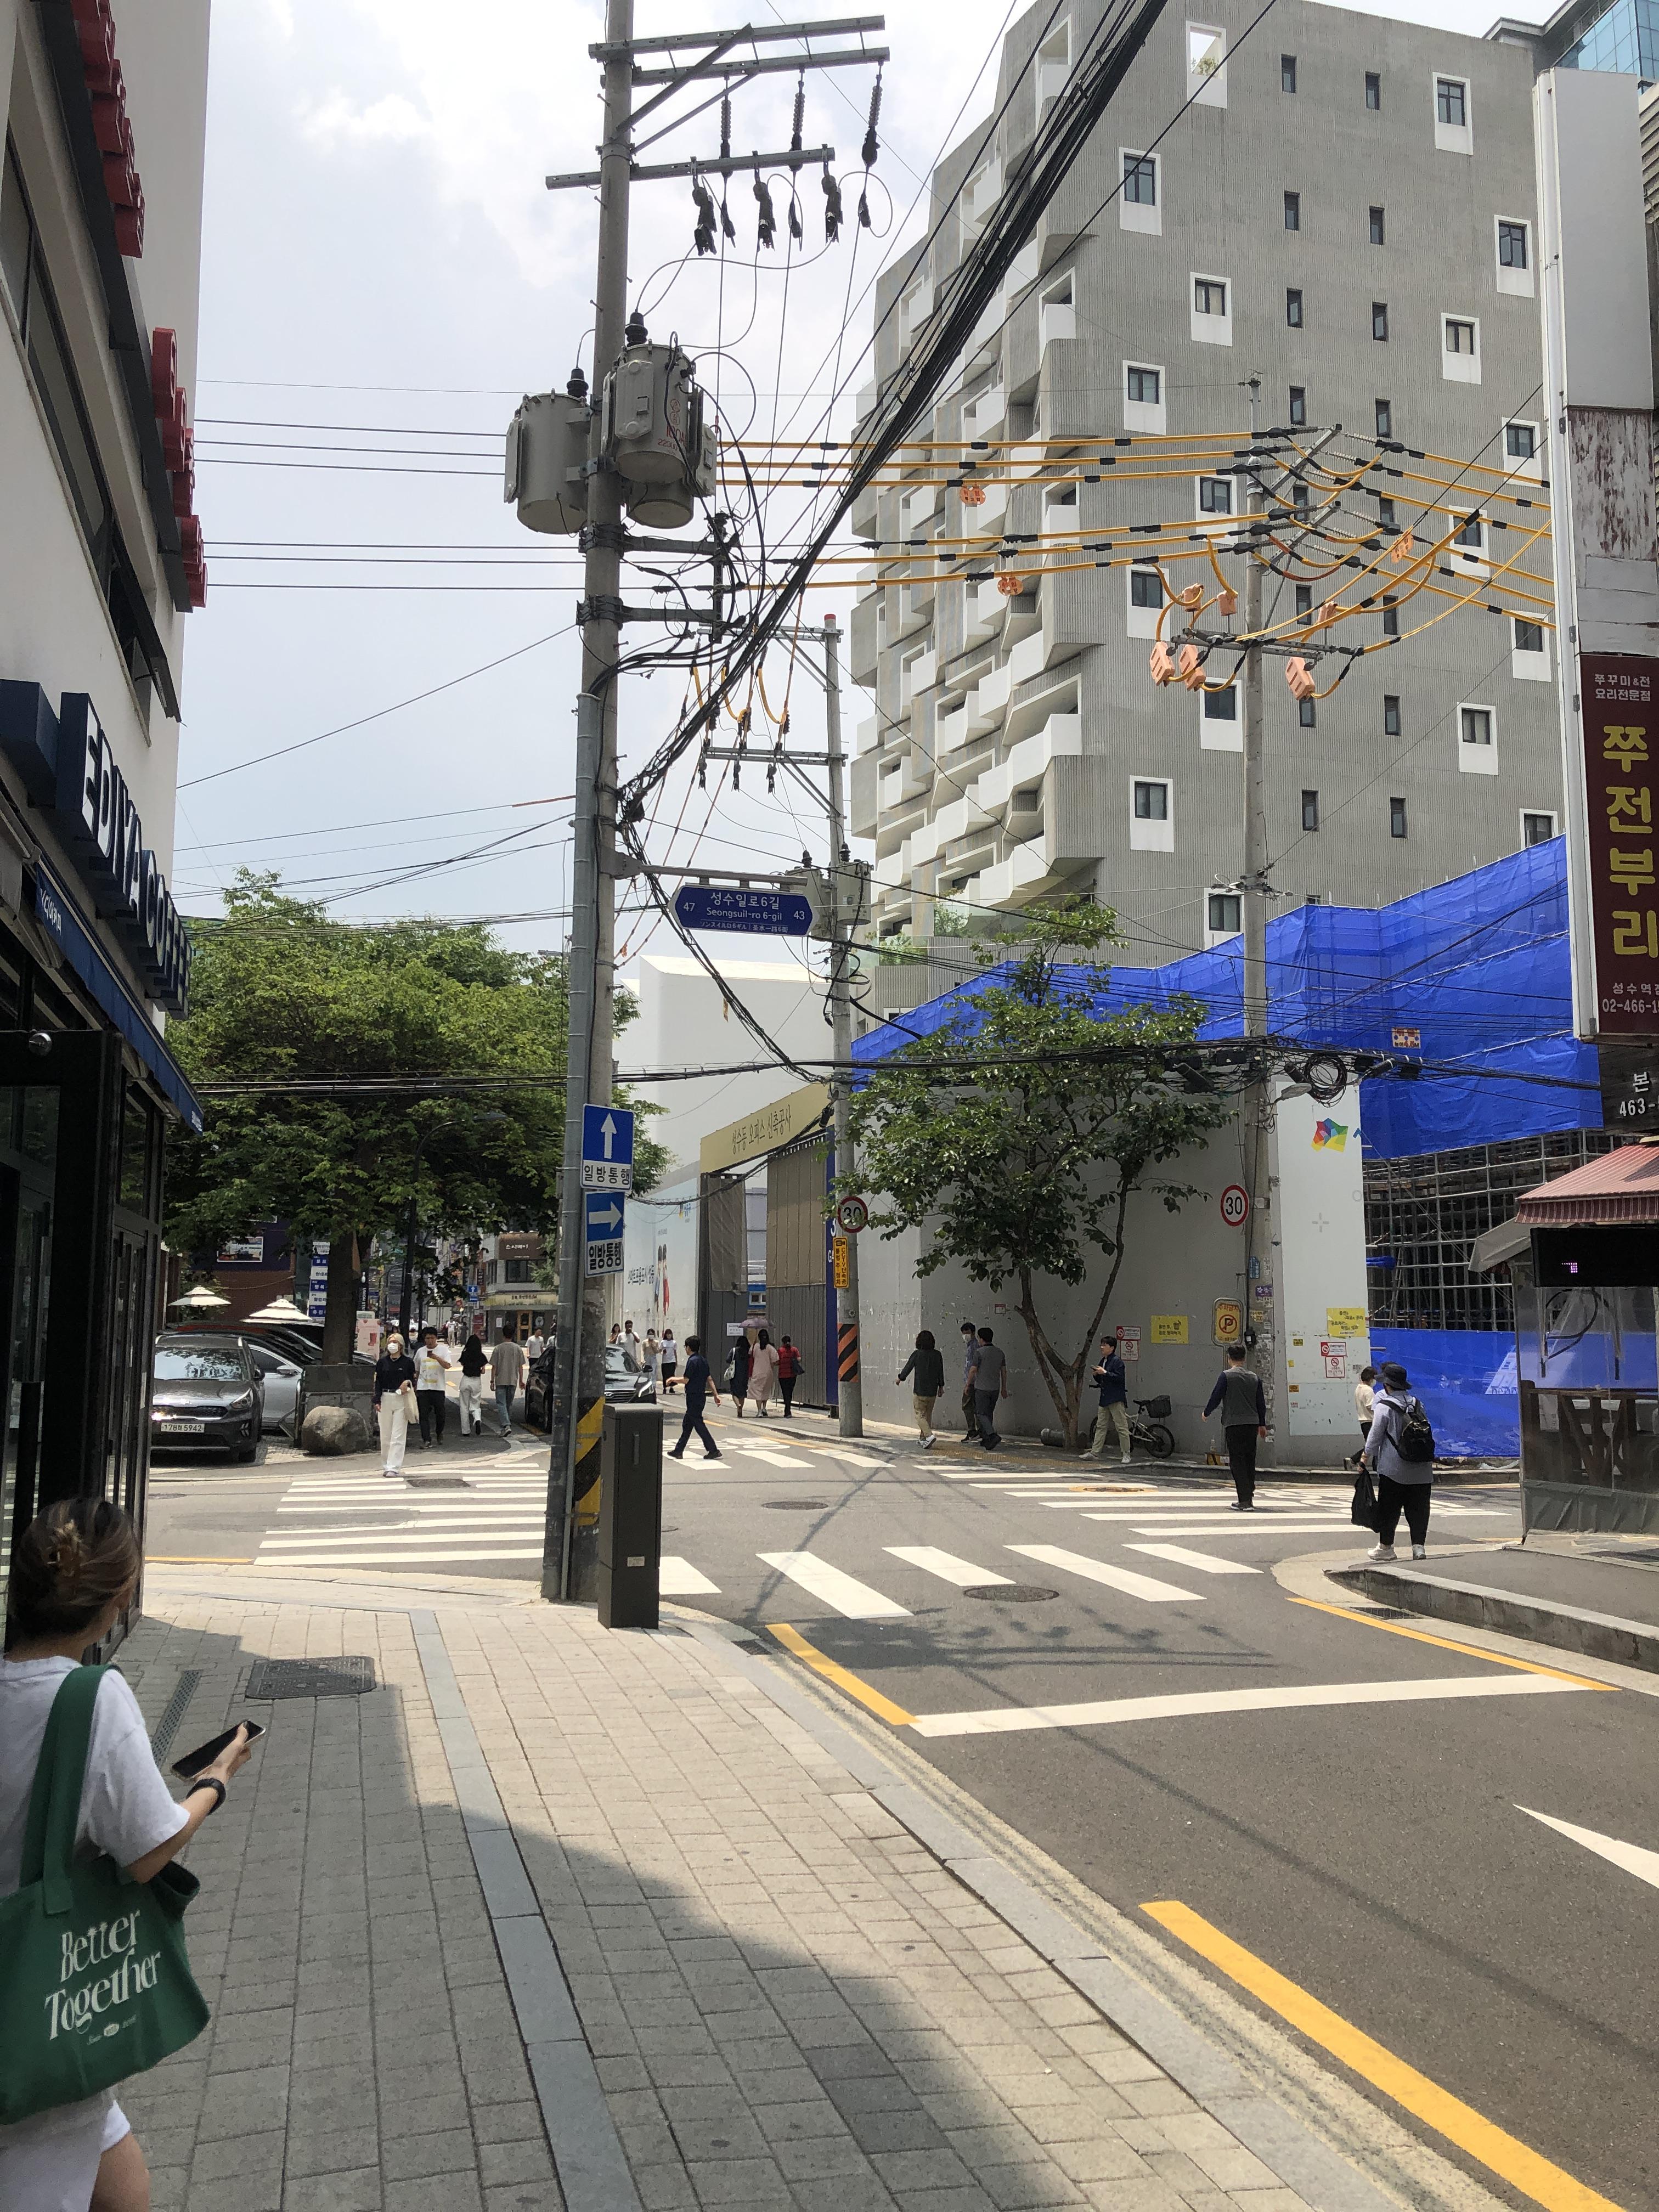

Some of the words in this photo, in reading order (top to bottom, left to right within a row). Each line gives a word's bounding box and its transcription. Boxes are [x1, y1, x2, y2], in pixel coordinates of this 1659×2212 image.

[1595, 689, 1650, 701] 요리전문점
[683, 902, 695, 912] 47
[710, 891, 780, 910] 성수일로6길
[707, 907, 761, 919] Seongsuil-ro
[763, 911, 782, 922] 6-gil
[793, 910, 805, 920] 43
[1633, 1071, 1650, 1092] 본
[1620, 1095, 1659, 1116] 463-
[732, 1126, 747, 1155] 성수동
[748, 1119, 765, 1144] 오피스
[767, 1104, 792, 1139] 신축공사
[584, 1164, 630, 1186] 일방통행
[843, 1206, 862, 1222] 30
[1226, 1196, 1243, 1215] 30
[589, 1242, 622, 1270] 일방통행
[60, 1909, 140, 1983] Better
[44, 1948, 161, 2040] Together
